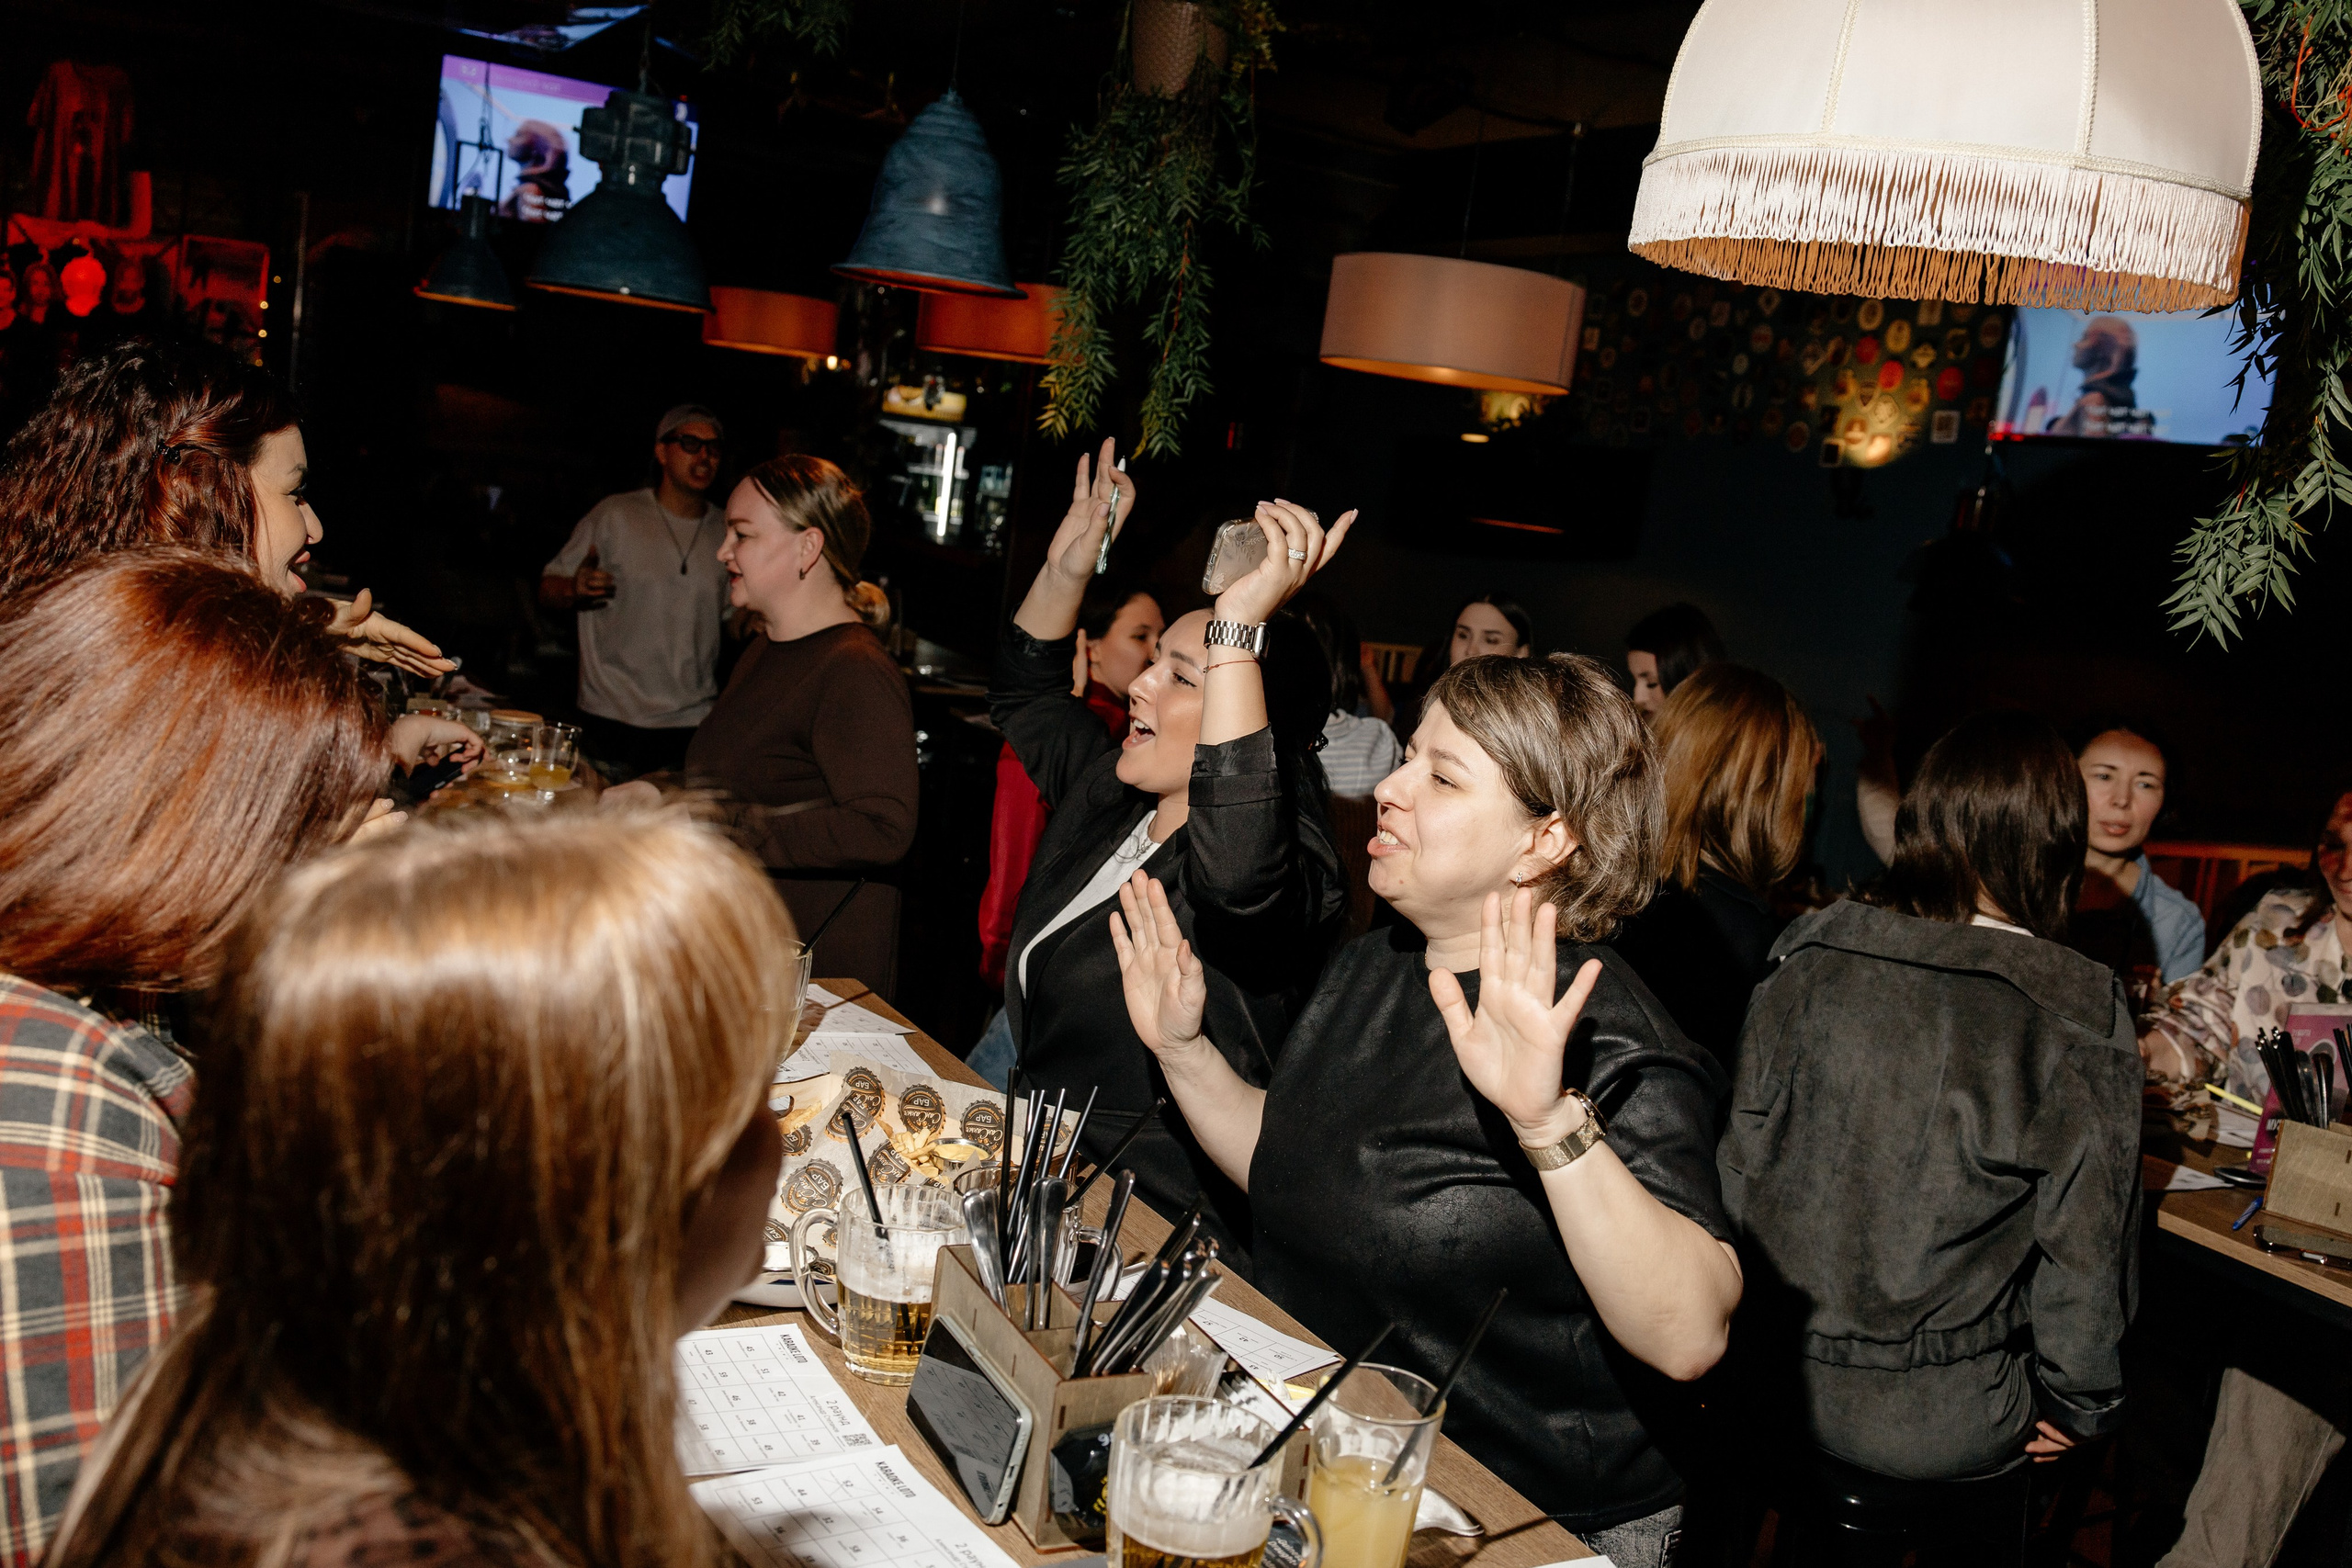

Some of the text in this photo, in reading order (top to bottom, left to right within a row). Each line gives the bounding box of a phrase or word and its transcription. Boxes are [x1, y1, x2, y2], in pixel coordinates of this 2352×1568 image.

[854, 1080, 870, 1089] БАР
[913, 1098, 930, 1107] БАР
[976, 1114, 992, 1123] БАР
[811, 1173, 830, 1190] БАР
[780, 1334, 800, 1353] KARAOKE
[792, 1353, 808, 1363] LOTO
[876, 1461, 903, 1485] KARAOKE
[896, 1484, 916, 1498] LOTO
